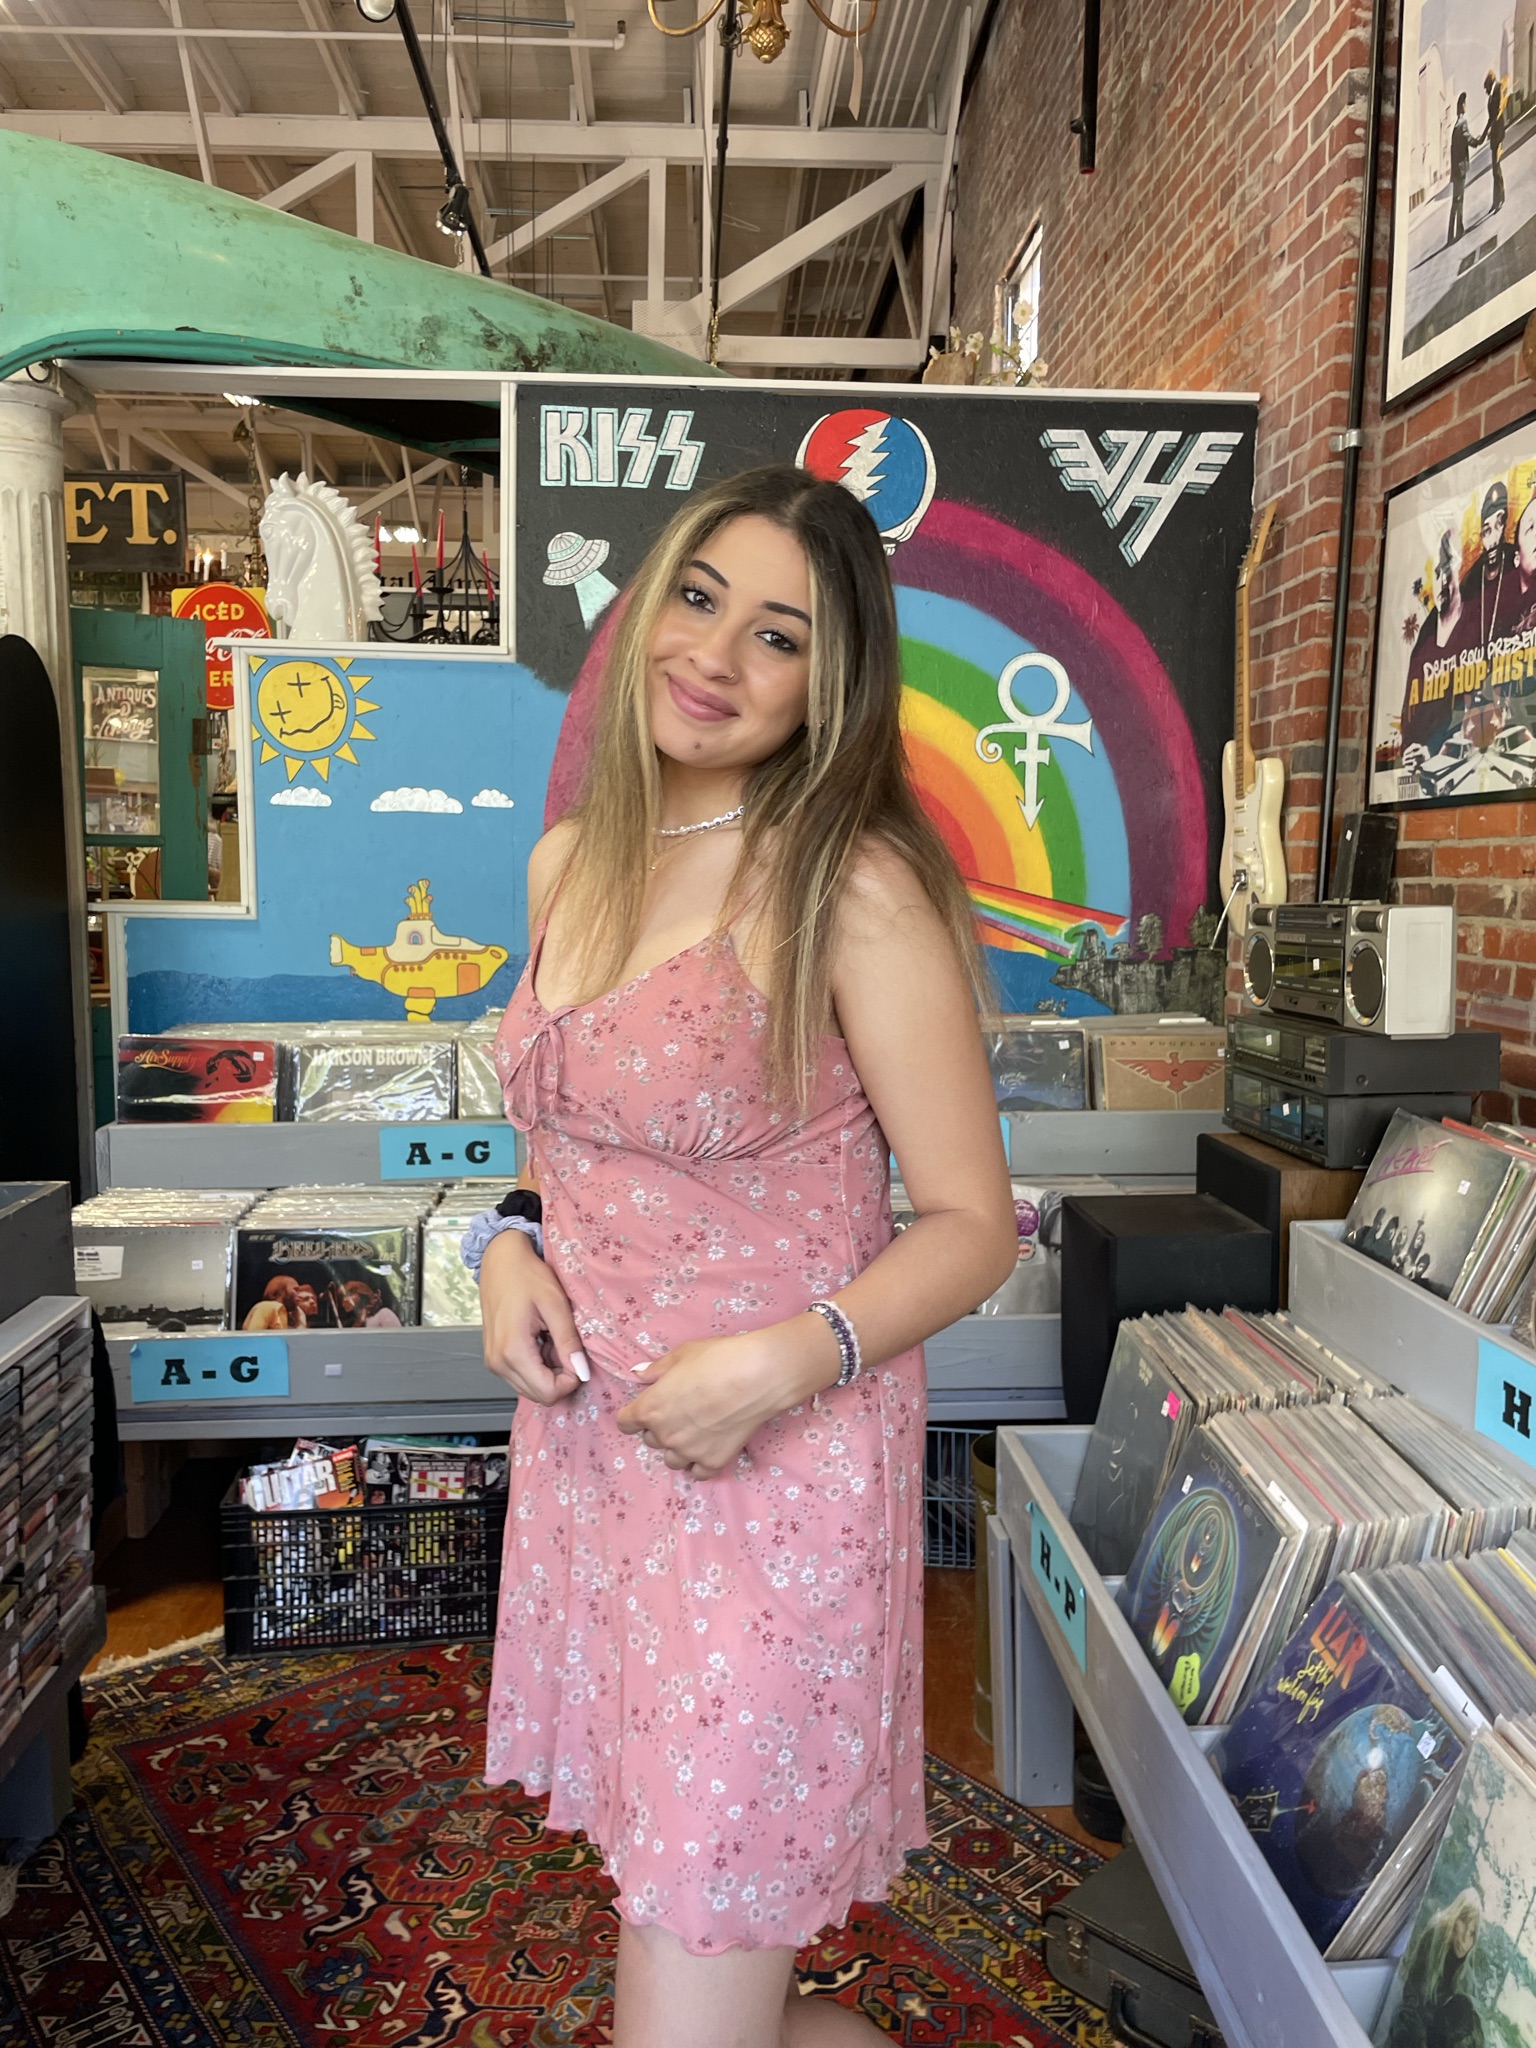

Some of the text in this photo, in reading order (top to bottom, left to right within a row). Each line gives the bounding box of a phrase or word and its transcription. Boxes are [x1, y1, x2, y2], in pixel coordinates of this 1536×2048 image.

[540, 400, 706, 490] KISS
[92, 683, 157, 708] ANTIQUES
[1408, 679, 1419, 706] A
[1422, 671, 1450, 702] HIP
[1453, 660, 1487, 696] HOP
[1502, 1380, 1532, 1439] H
